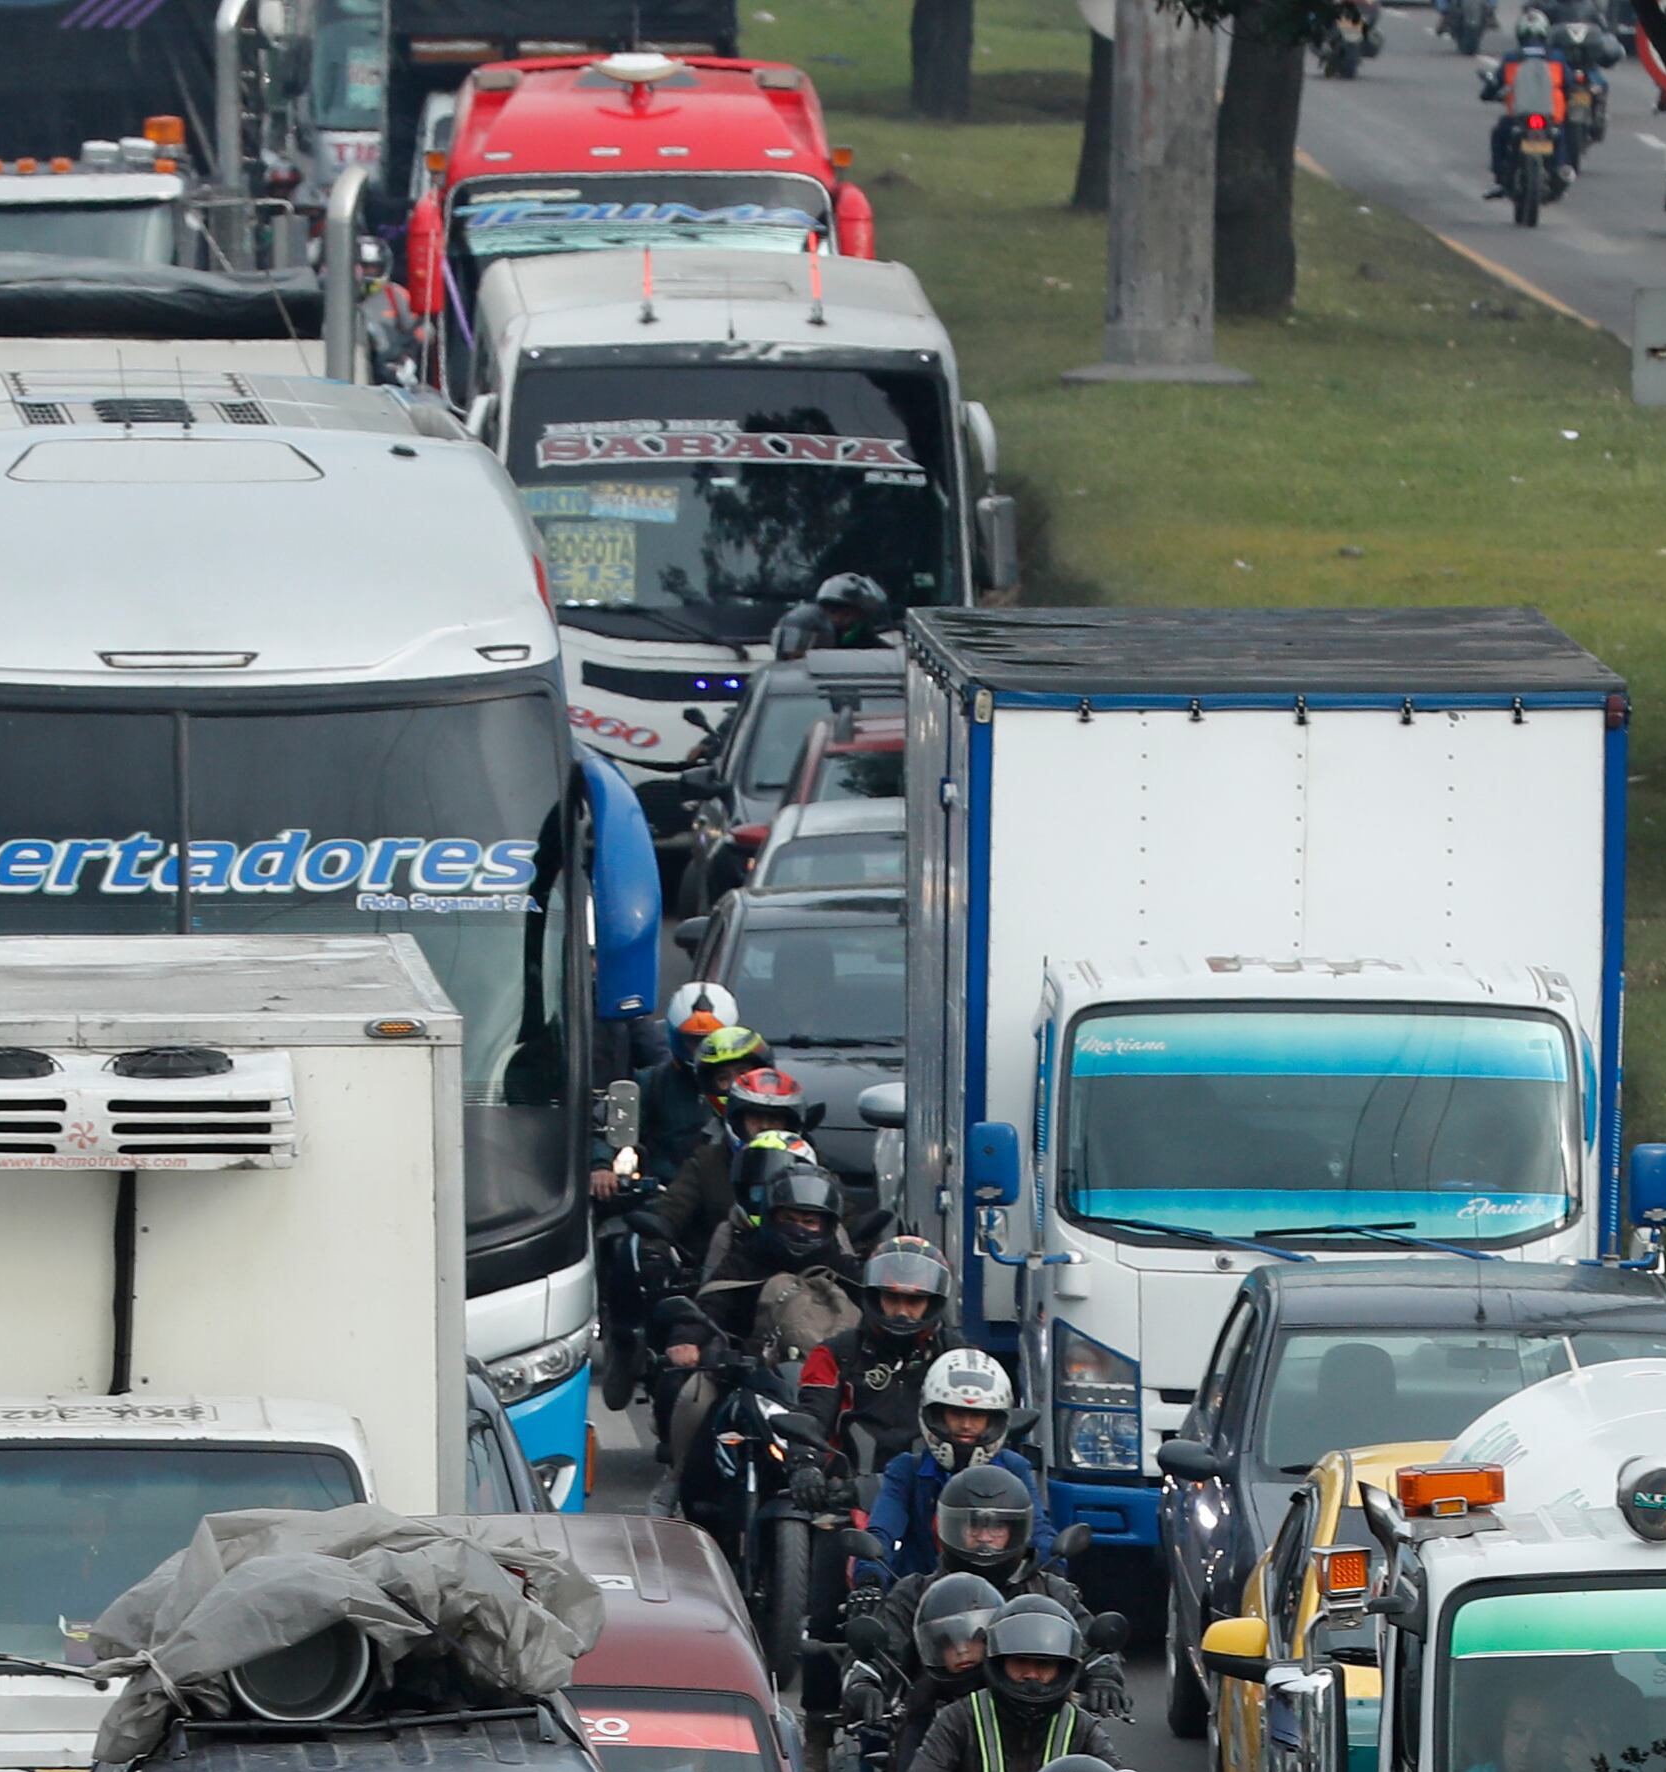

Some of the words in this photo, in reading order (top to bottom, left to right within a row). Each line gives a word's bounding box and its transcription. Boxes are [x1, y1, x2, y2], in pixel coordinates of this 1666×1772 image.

[536, 431, 927, 470] SABANA
[549, 534, 635, 563] BOGOTA
[1079, 1036, 1166, 1056] Mariana
